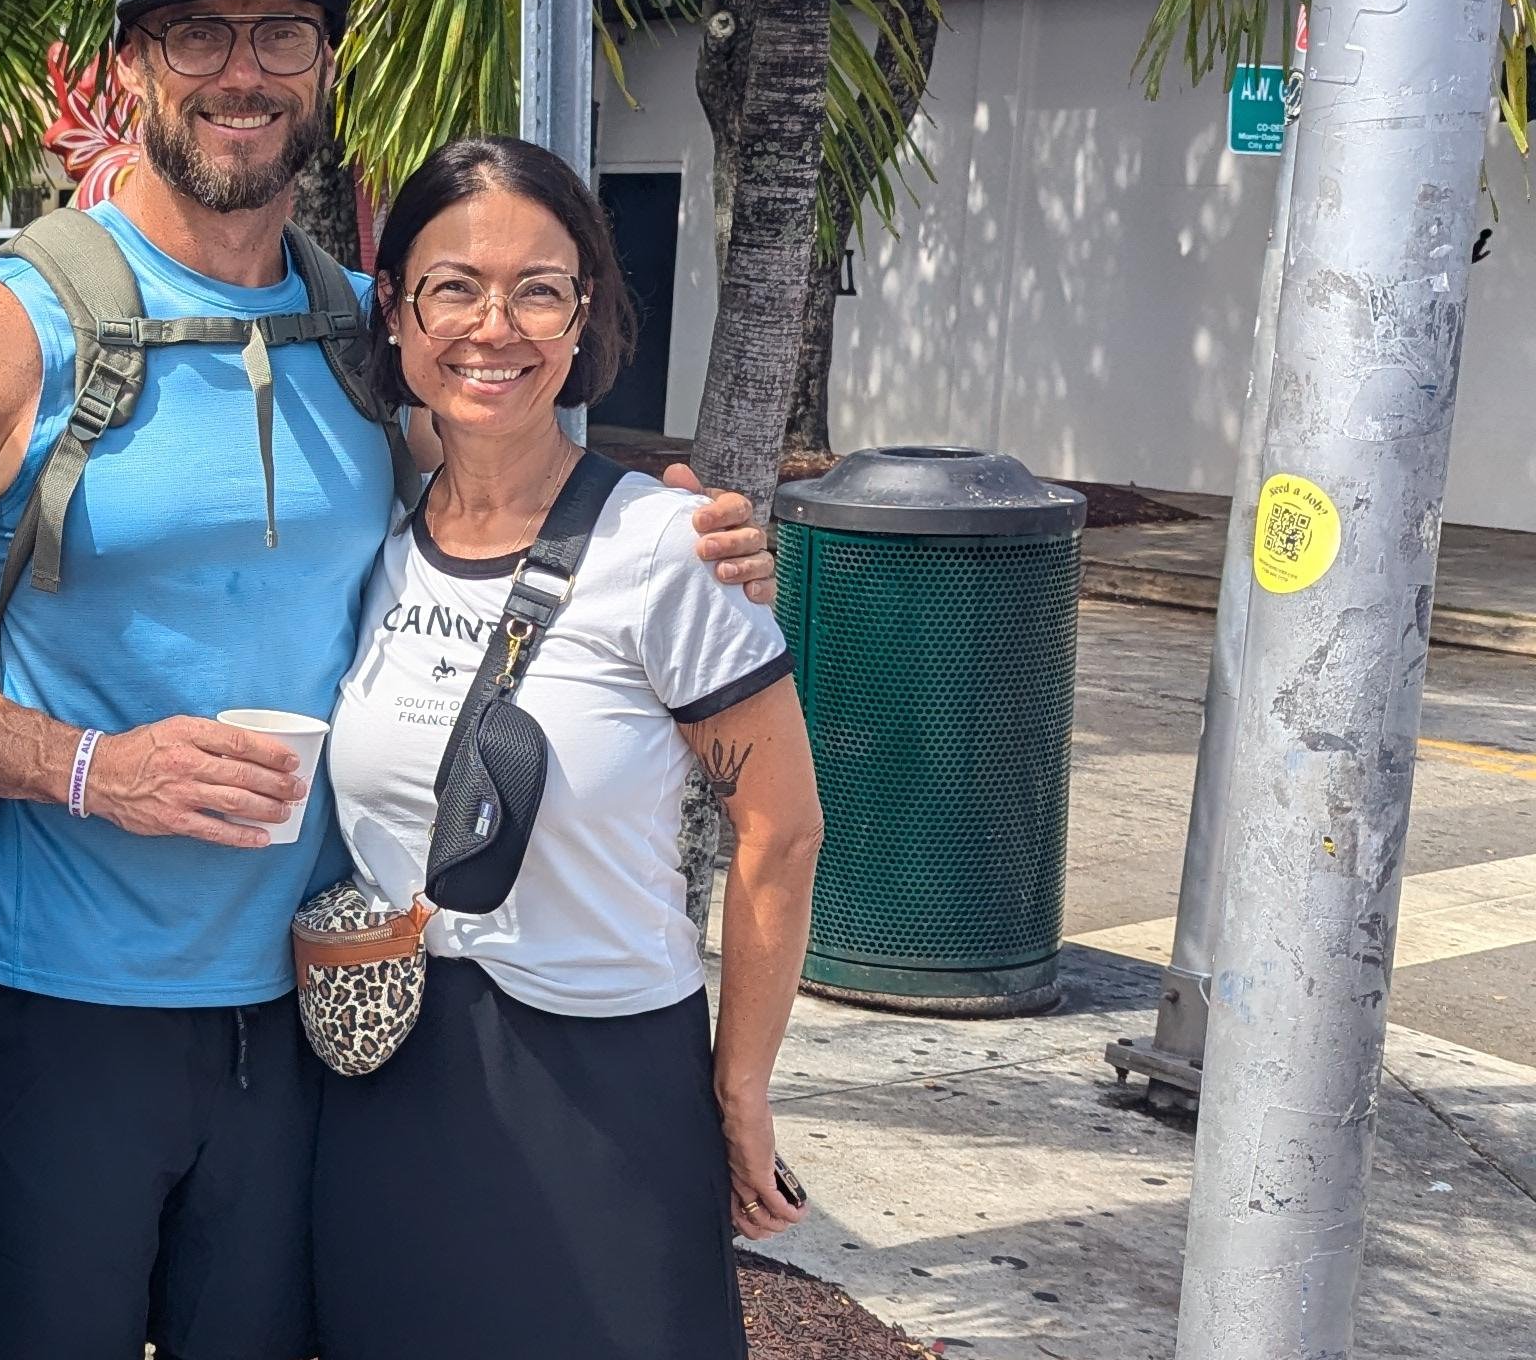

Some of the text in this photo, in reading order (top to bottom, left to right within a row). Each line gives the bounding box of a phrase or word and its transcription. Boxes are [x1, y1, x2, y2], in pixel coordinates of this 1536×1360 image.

[1293, 487, 1301, 496] a
[1303, 492, 1328, 515] Job?
[394, 696, 463, 711] SOUTH O
[398, 711, 457, 727] FRANCE
[72, 759, 86, 805] TOWERS
